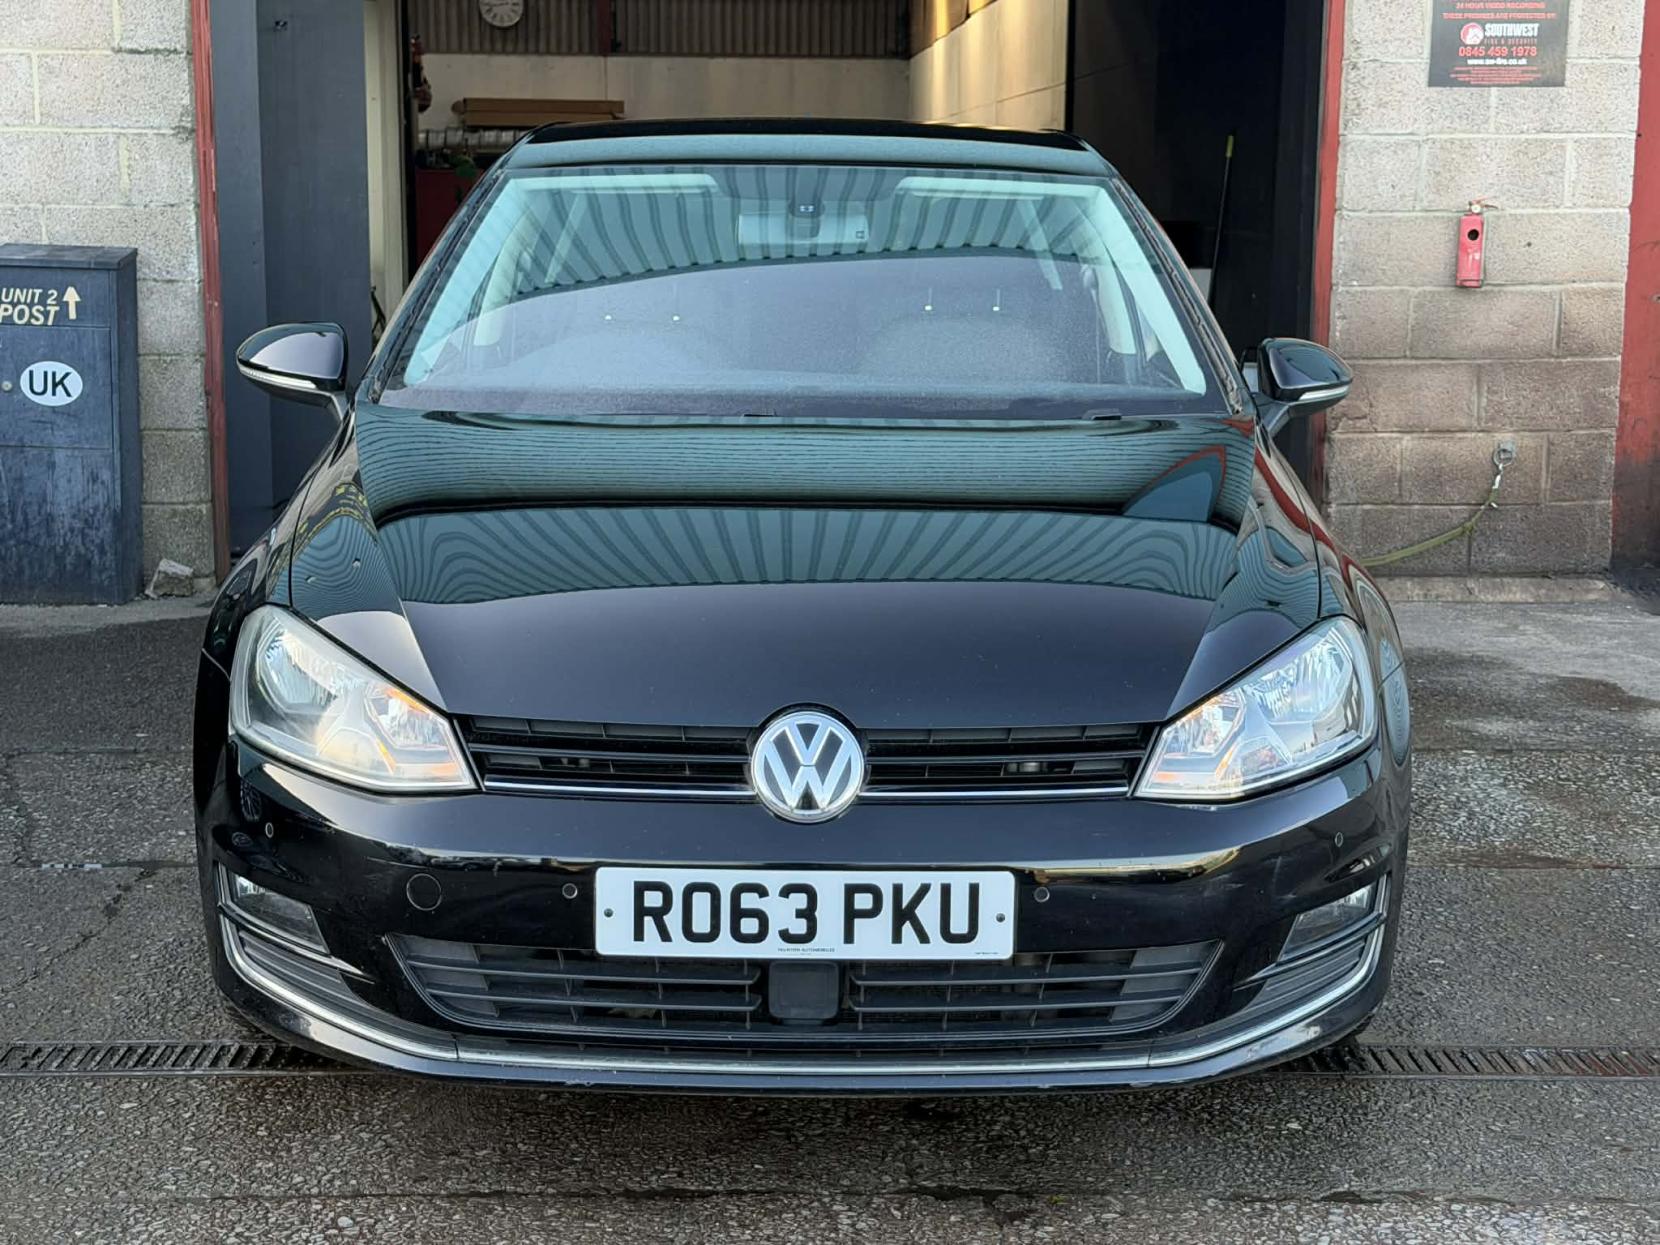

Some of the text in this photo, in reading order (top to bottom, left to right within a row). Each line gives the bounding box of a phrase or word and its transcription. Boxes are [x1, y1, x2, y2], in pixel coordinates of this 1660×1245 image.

[1484, 23, 1540, 37] SOUTHWEST
[1459, 46, 1485, 57] 0845
[1488, 46, 1508, 57] 459
[1, 288, 58, 305] UNIT 2
[0, 304, 60, 325] POST
[28, 370, 73, 398] UK
[633, 880, 980, 945] RO63 PKU
